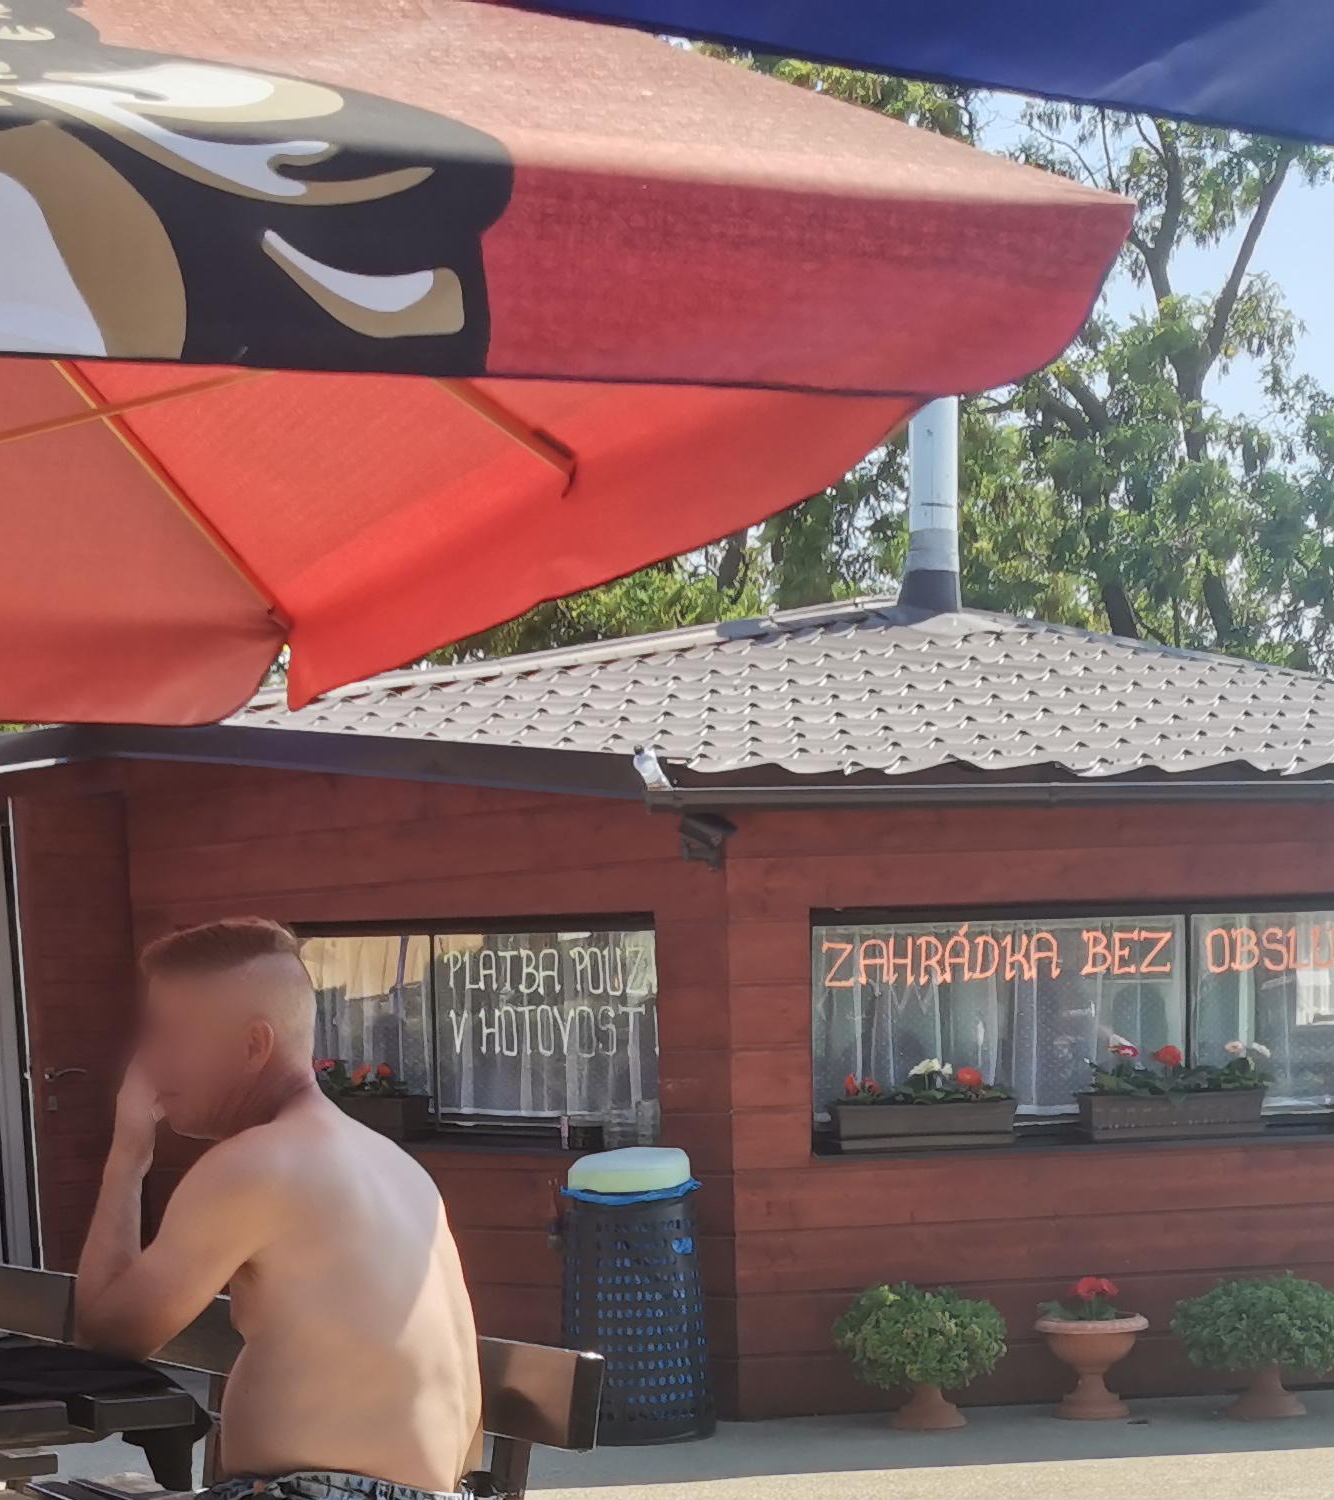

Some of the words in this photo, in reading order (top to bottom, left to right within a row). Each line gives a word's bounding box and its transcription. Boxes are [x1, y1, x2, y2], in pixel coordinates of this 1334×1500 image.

[443, 947, 562, 993] PLATBA
[821, 922, 1062, 987] ZAHRÁDKA
[1080, 927, 1174, 976] BEZ
[449, 1007, 469, 1056] V
